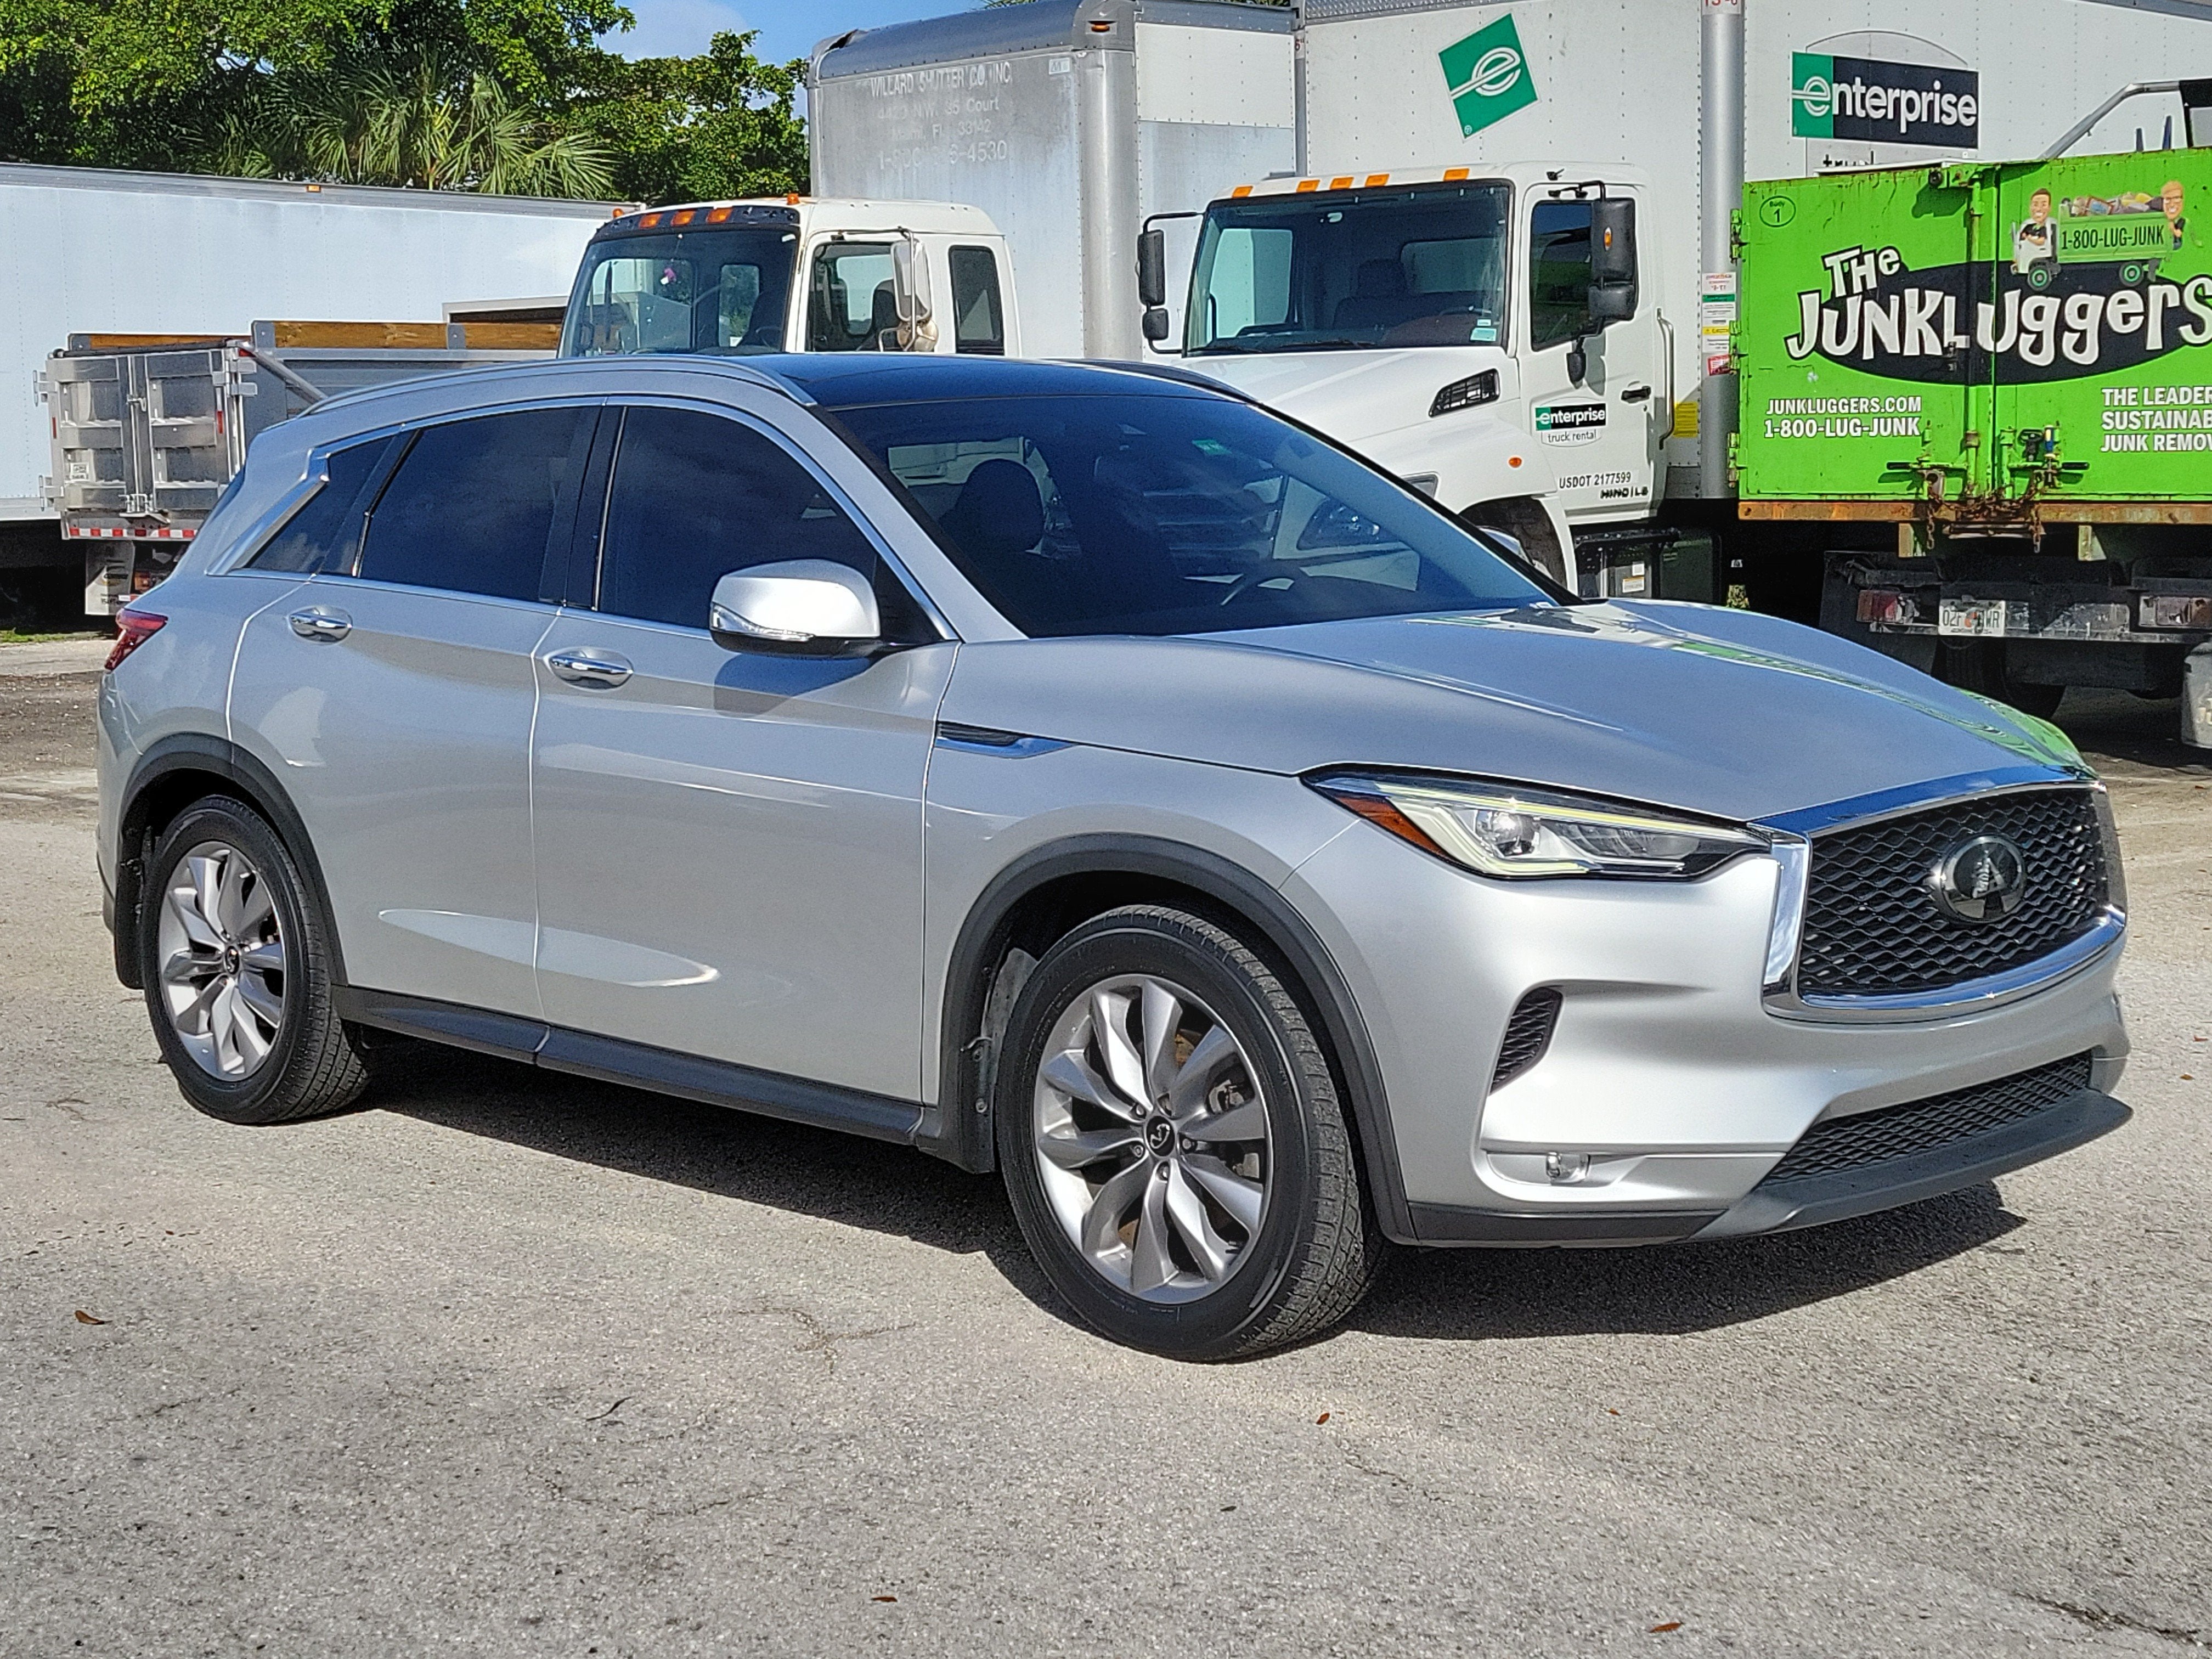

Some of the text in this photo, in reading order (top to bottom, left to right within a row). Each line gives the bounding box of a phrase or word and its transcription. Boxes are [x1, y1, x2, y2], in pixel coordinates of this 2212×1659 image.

[871, 72, 914, 98] WILLARD
[966, 97, 1000, 112] Court
[1792, 76, 1977, 133] enterprise
[1774, 208, 1780, 222] 1
[2062, 225, 2164, 250] 1-800-LUG-JUNK
[1766, 396, 1921, 415] JUNKLUGGERS.COM
[2101, 387, 2139, 406] THE
[1537, 408, 1605, 425] enterprise
[1548, 429, 1596, 443] truck rental
[1764, 416, 1920, 438] 1-800-LUG-JUNK
[2100, 434, 2149, 452] JUNK
[1559, 472, 1631, 489] USDOT 2177599
